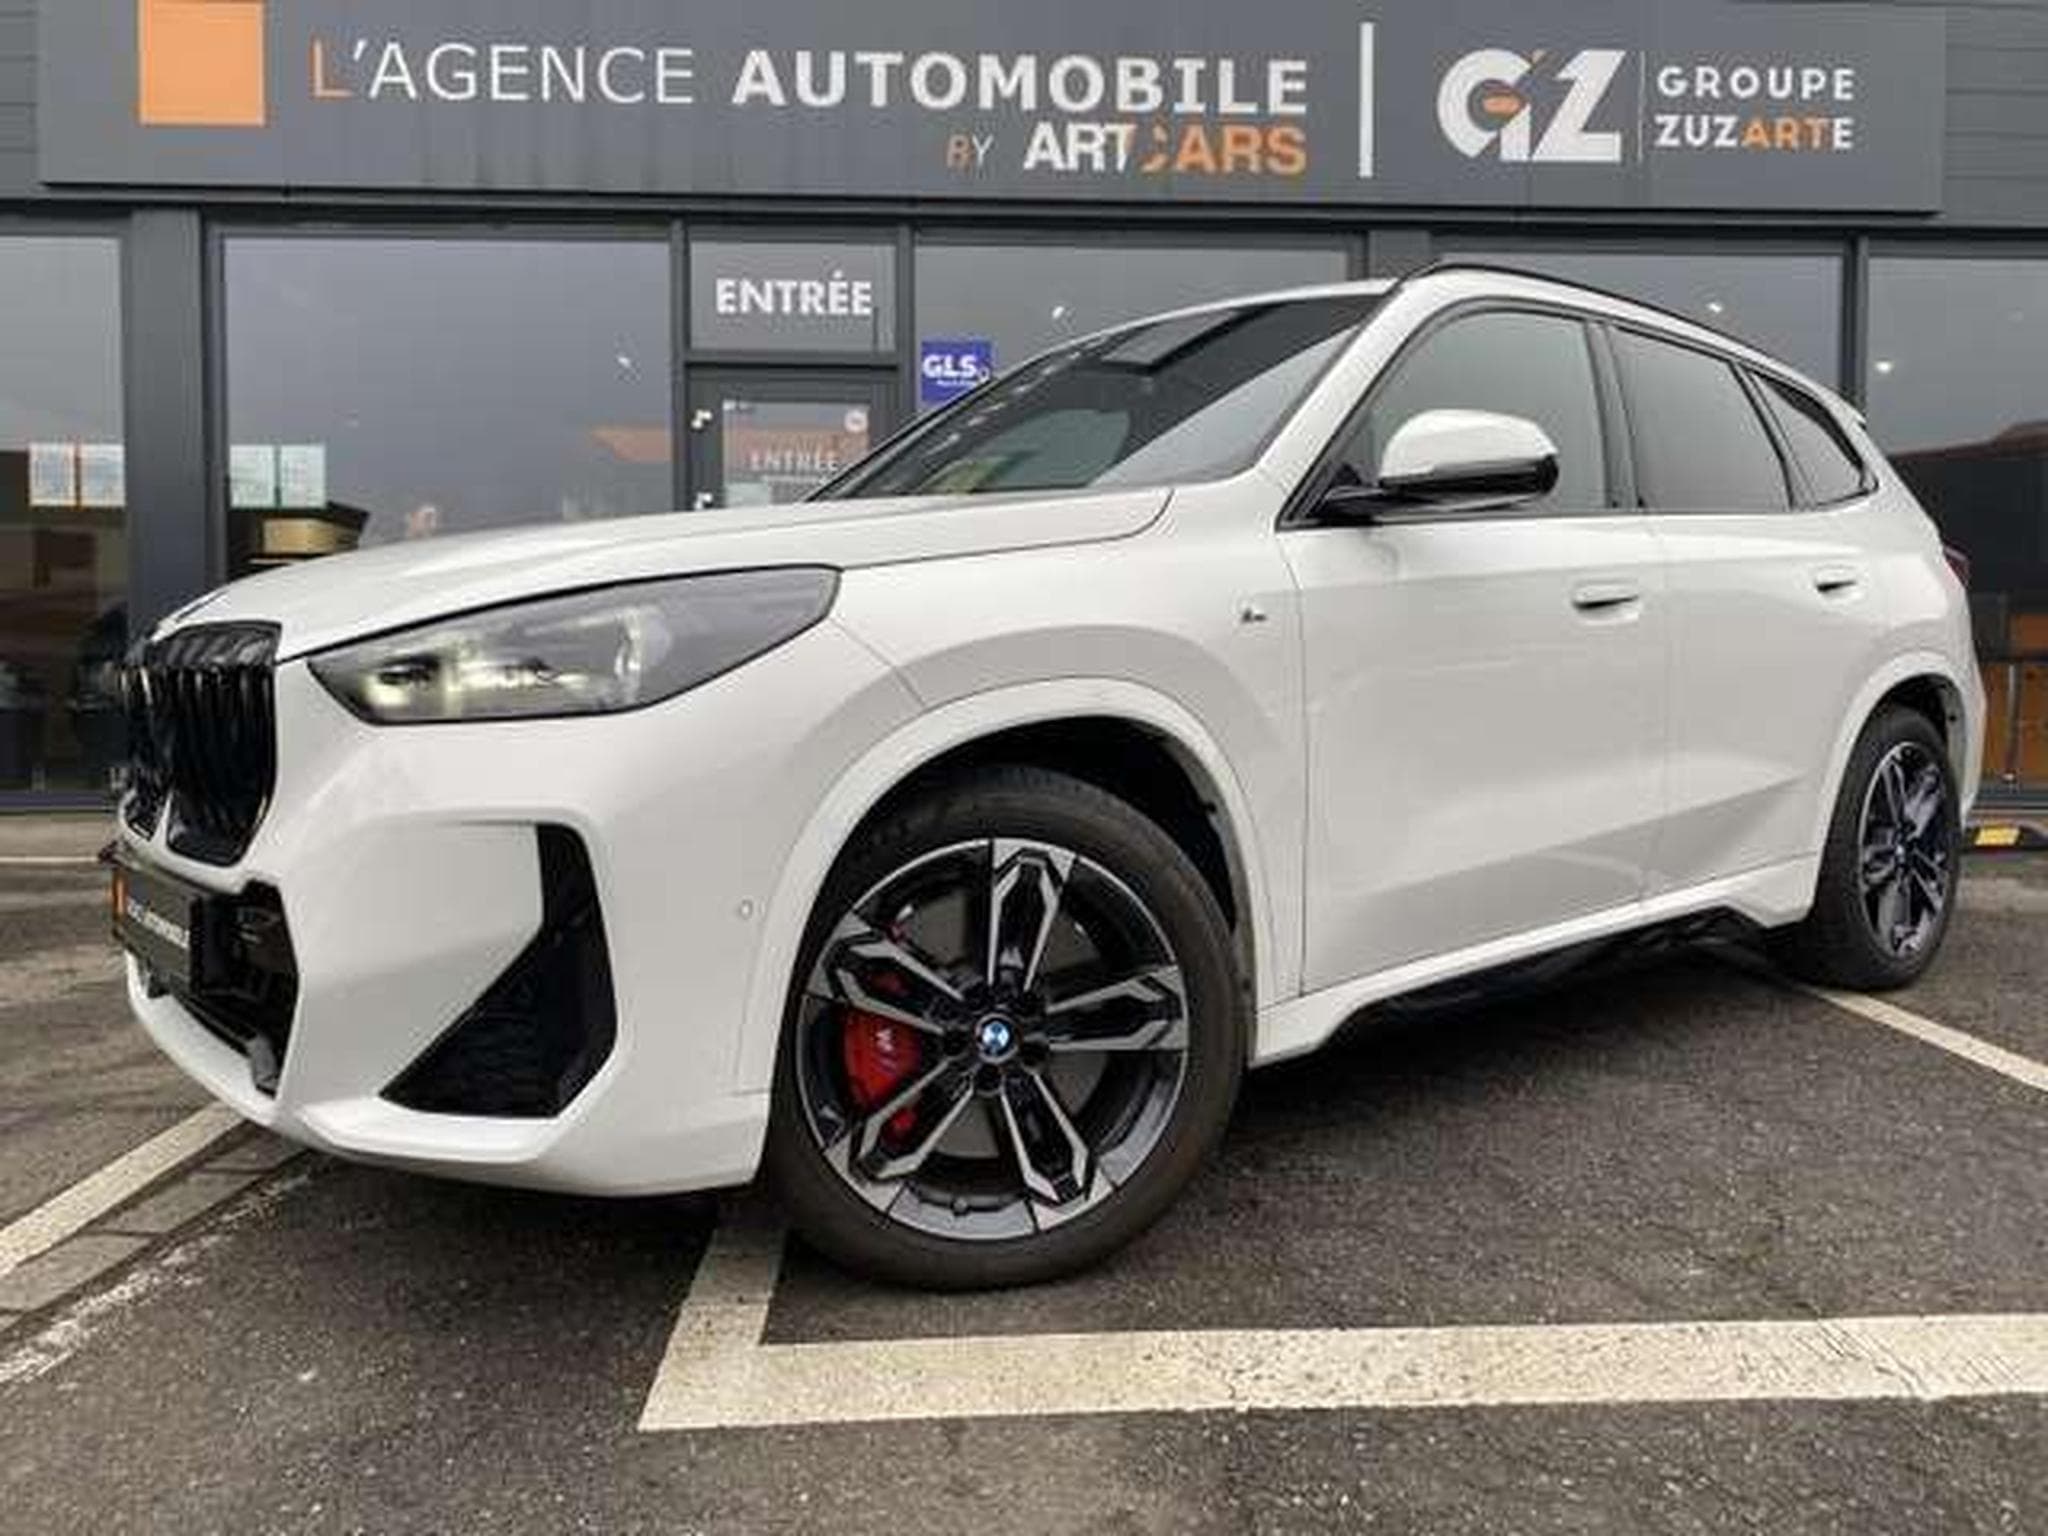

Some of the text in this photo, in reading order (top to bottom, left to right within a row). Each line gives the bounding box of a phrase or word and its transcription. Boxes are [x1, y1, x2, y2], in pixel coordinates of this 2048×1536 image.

[311, 38, 1308, 115] L'AGENCE AUTOMOBILE
[1656, 66, 1856, 101] GROUPE
[946, 134, 995, 166] BY
[1654, 114, 1856, 151] ZUZARTE
[715, 268, 873, 316] ENTRÉE
[922, 353, 978, 378] GLS
